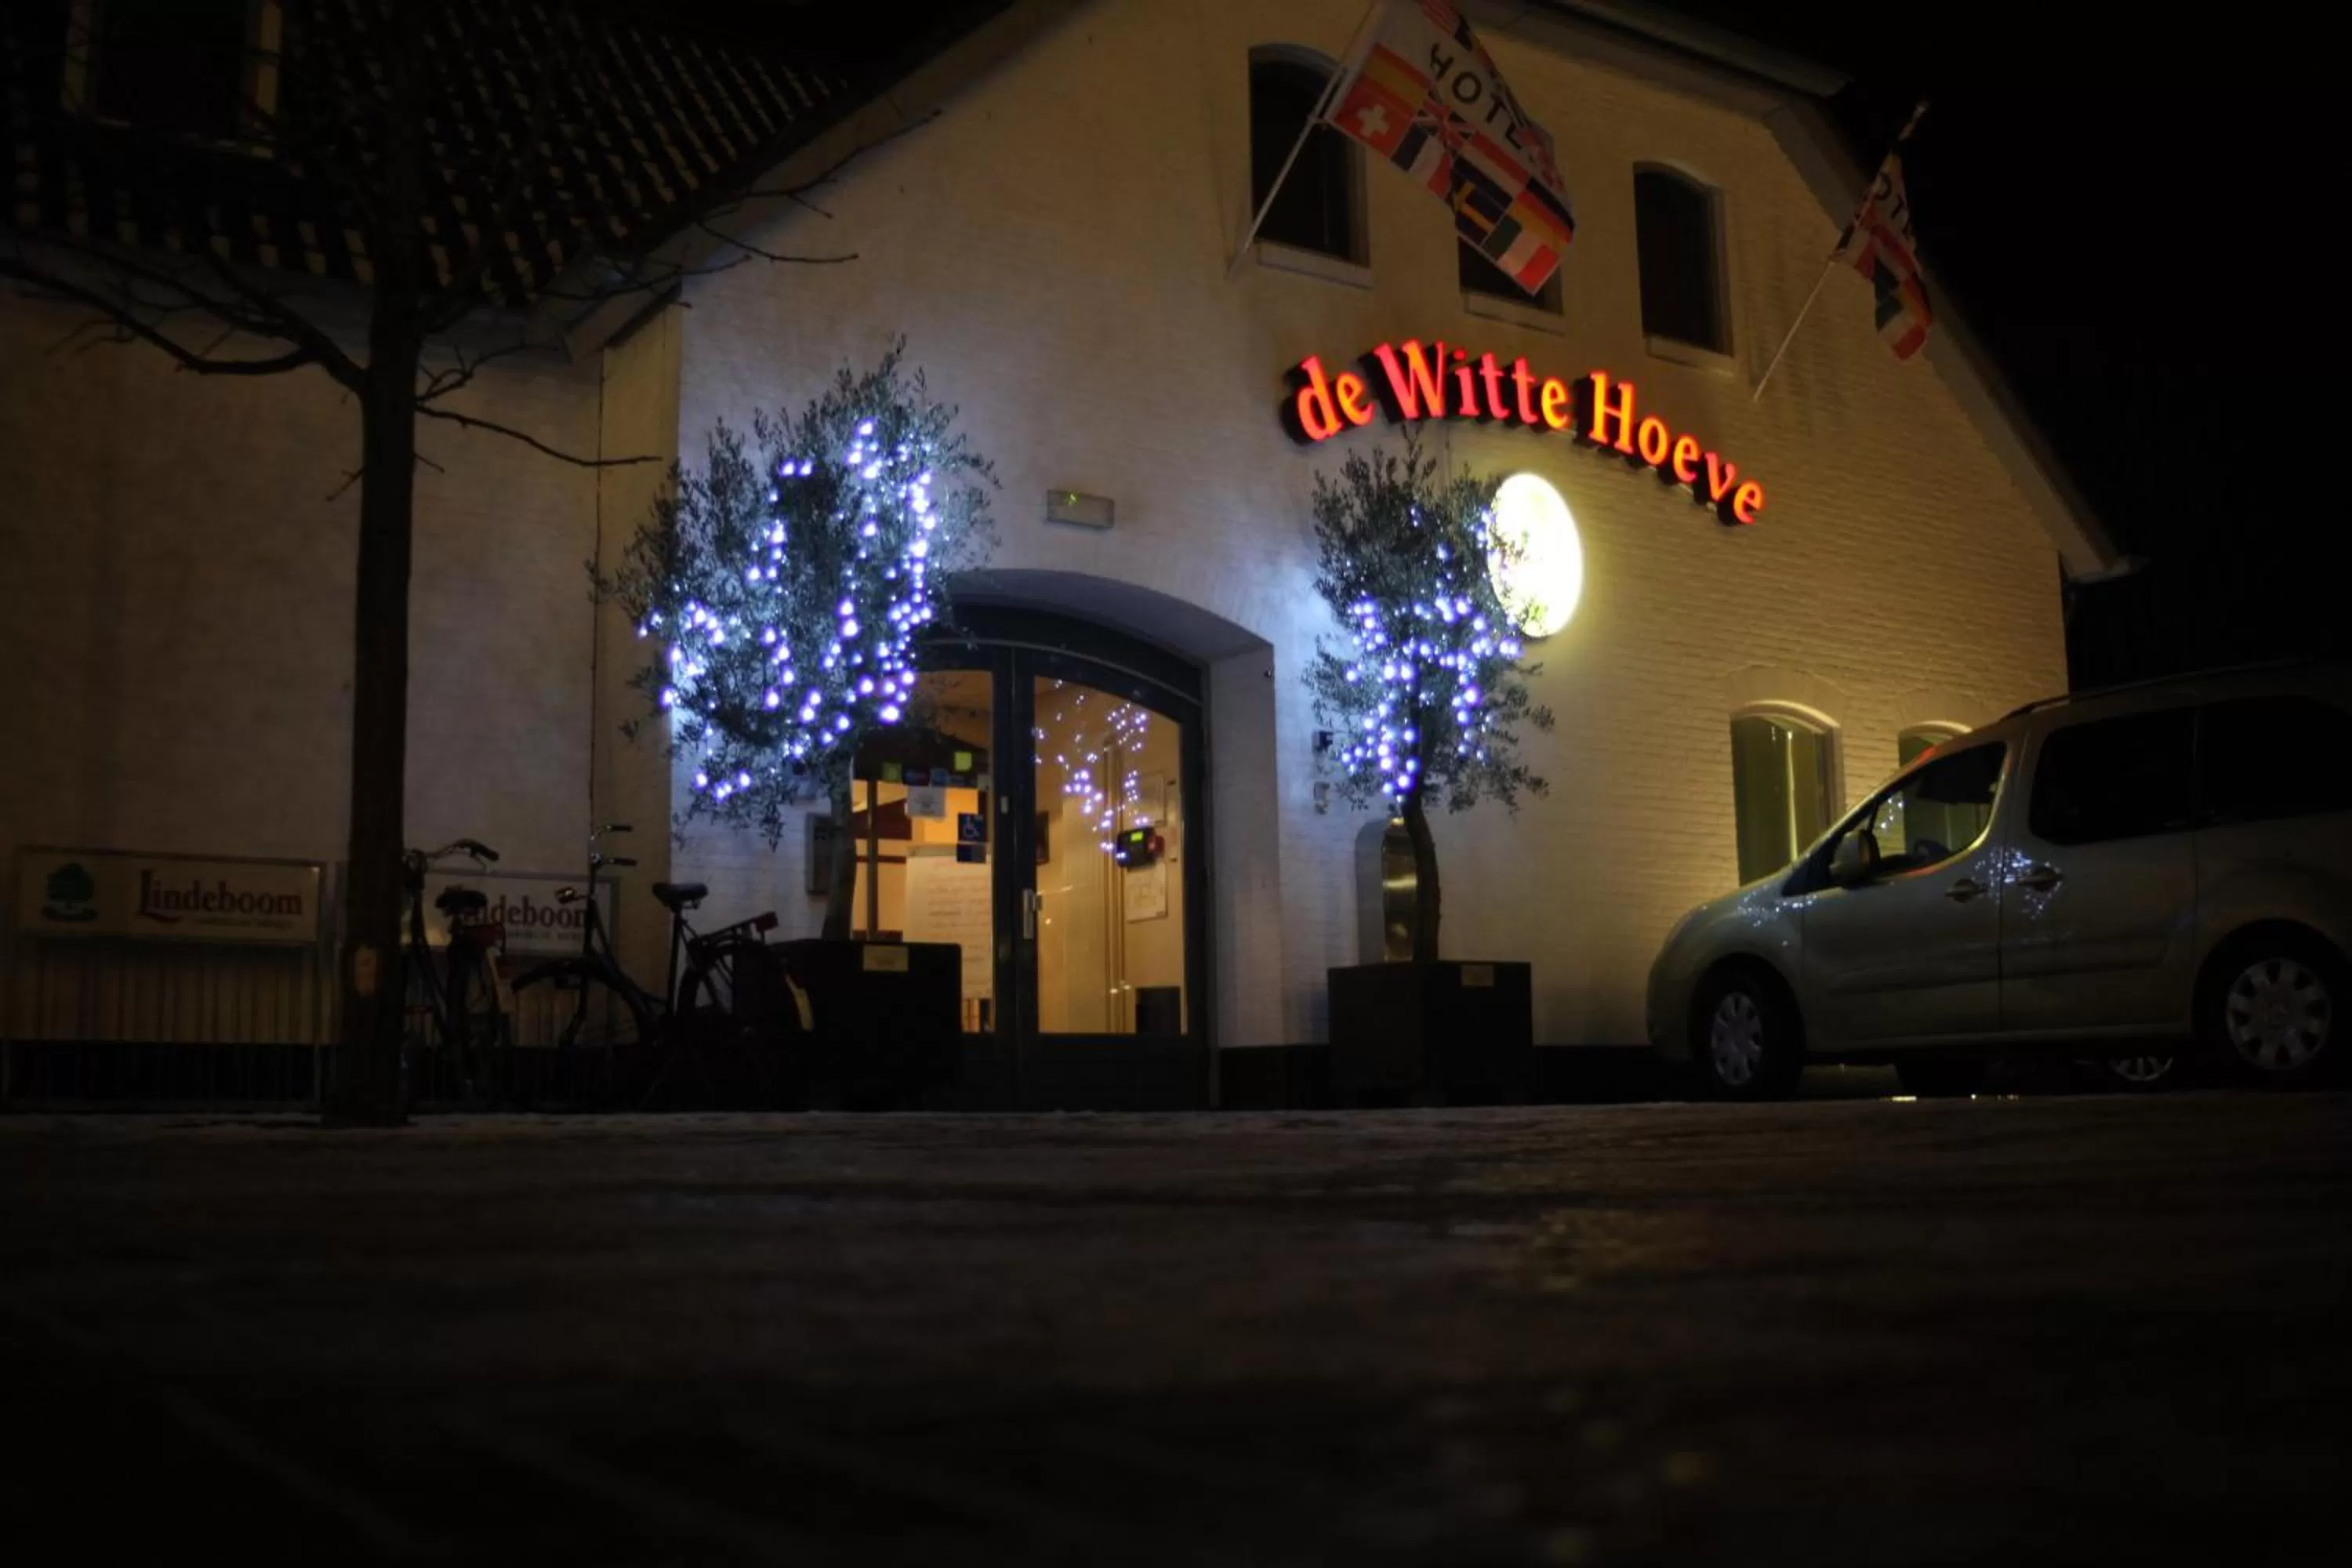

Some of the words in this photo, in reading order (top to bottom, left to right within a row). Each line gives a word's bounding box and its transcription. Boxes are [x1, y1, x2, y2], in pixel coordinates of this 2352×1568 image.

[1294, 354, 1374, 442] de
[1373, 338, 1570, 430] Witte
[1588, 370, 1764, 525] Hoeve
[136, 869, 303, 923] Lindeboom
